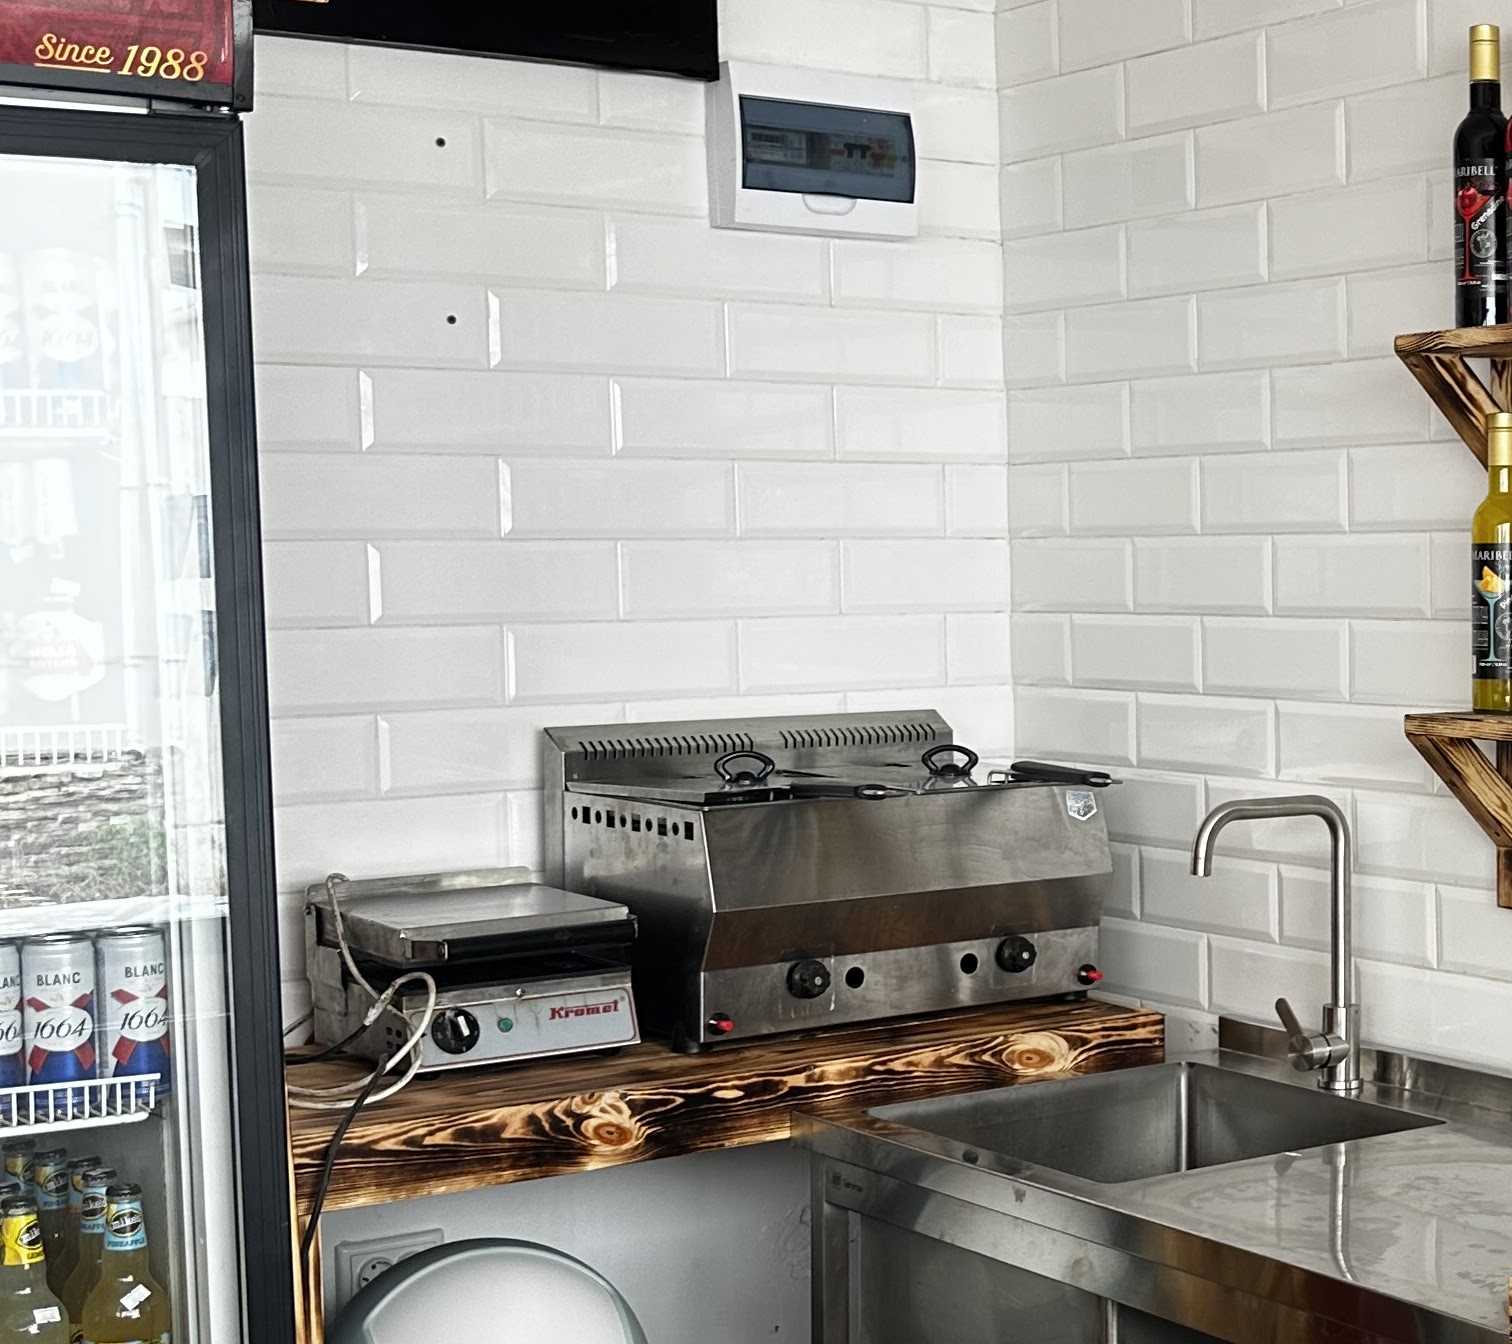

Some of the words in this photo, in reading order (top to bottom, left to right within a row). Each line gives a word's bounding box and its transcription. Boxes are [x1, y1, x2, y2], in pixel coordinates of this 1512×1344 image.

[35, 33, 114, 64] Since
[117, 45, 208, 82] 1988
[36, 972, 82, 987] BLANC
[124, 962, 165, 979] BLANC
[120, 1006, 168, 1032] 1664
[548, 999, 619, 1021] Kromet
[33, 1016, 89, 1040] 1664
[107, 1237, 146, 1248] PINEAPPLE
